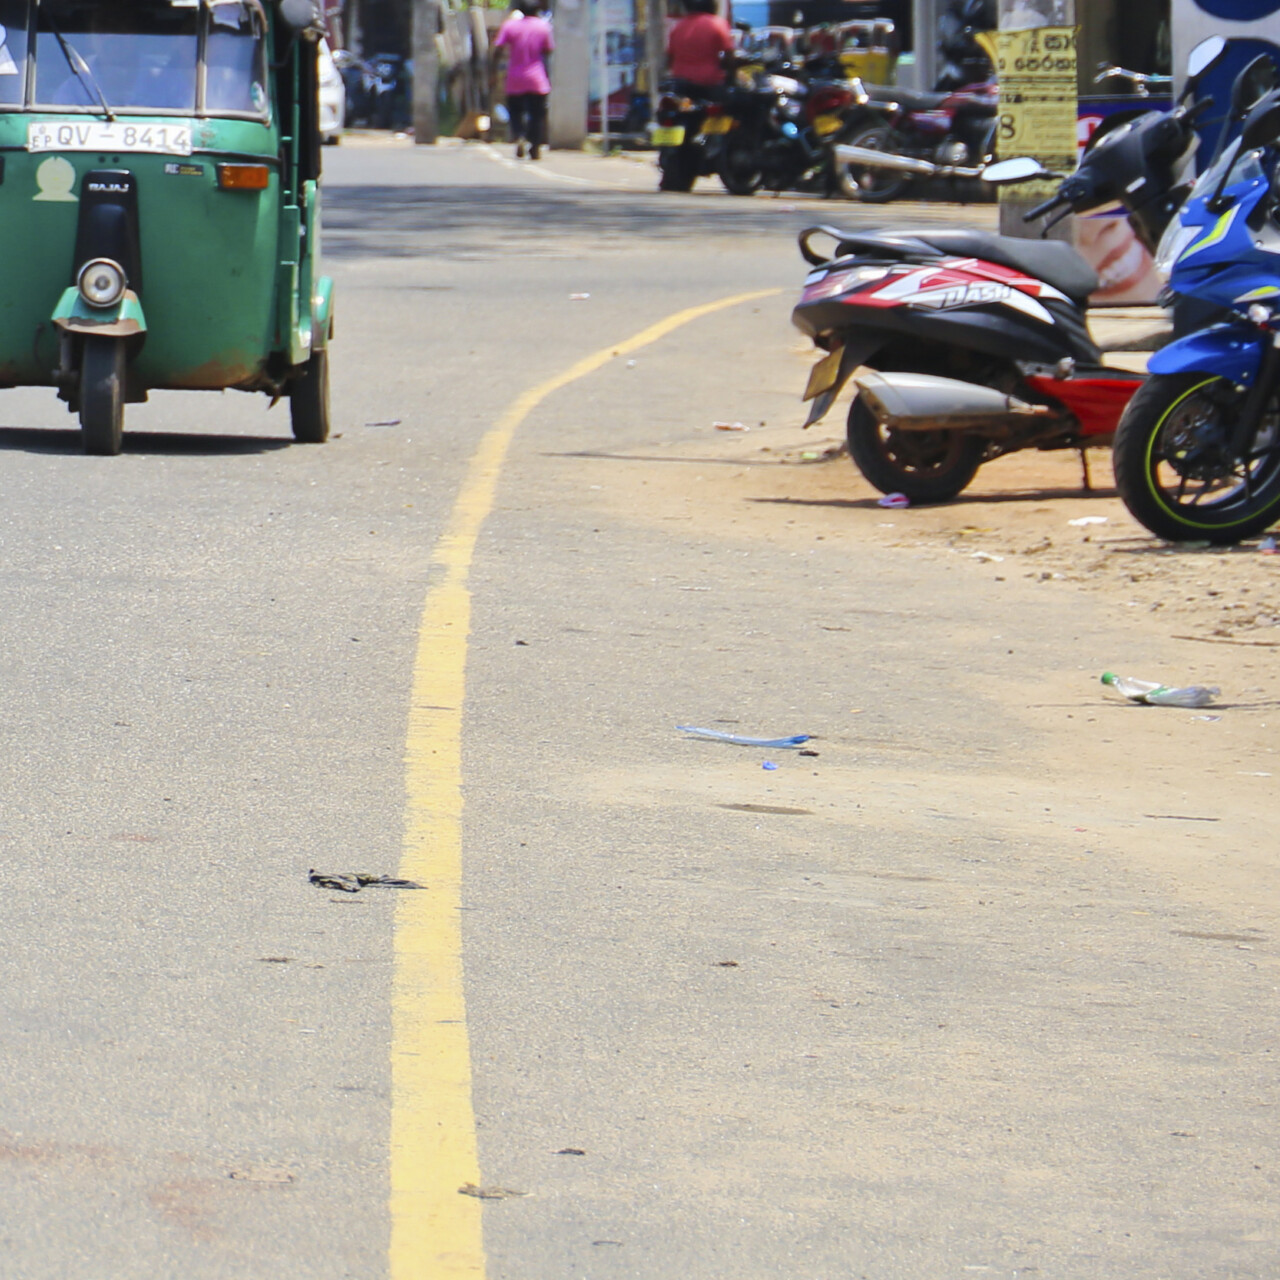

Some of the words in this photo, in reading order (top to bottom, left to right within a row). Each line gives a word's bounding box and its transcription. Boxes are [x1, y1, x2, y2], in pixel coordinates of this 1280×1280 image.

[58, 125, 92, 146] QV
[123, 126, 189, 150] 8414
[88, 183, 130, 192] BAJAJ
[940, 284, 1012, 308] DASH
